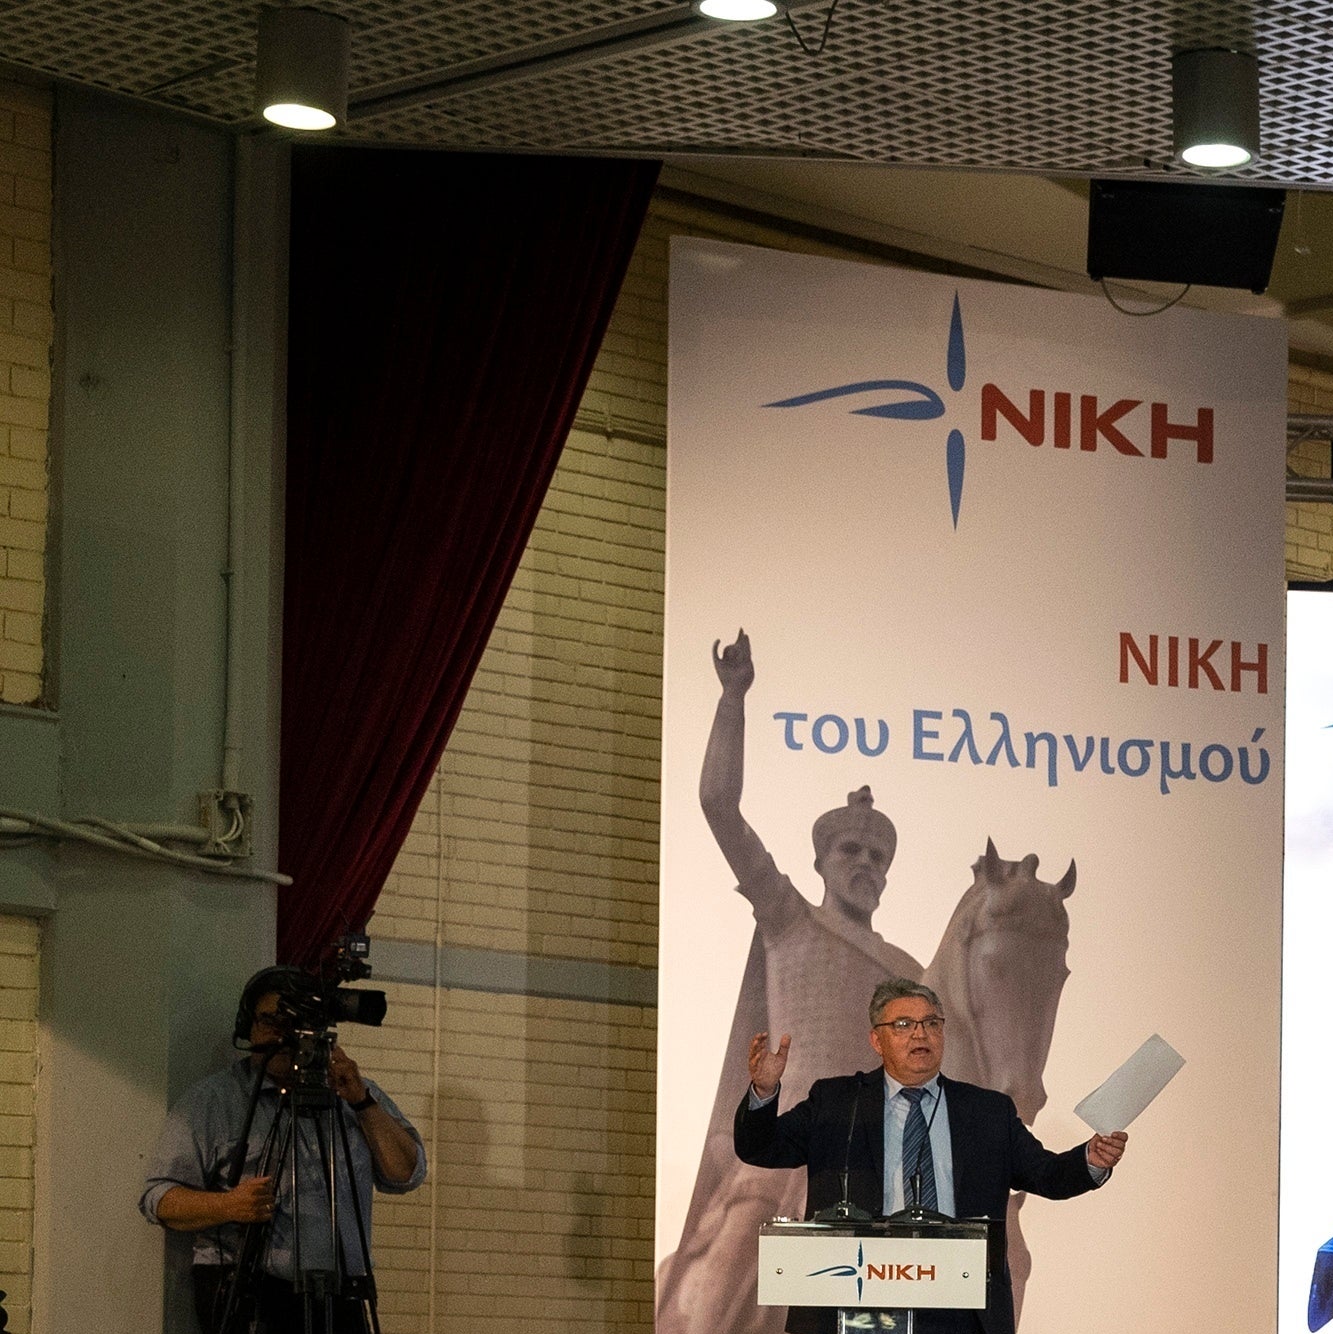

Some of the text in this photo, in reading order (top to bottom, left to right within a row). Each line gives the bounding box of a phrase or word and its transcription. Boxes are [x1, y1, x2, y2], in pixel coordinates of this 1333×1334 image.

[981, 383, 1214, 464] ΝΙΚΗ
[1119, 632, 1269, 694] ΝΙΚΗ
[773, 708, 1272, 795] του Ελληνισμού
[867, 1264, 936, 1281] ΝΙΚΗ
